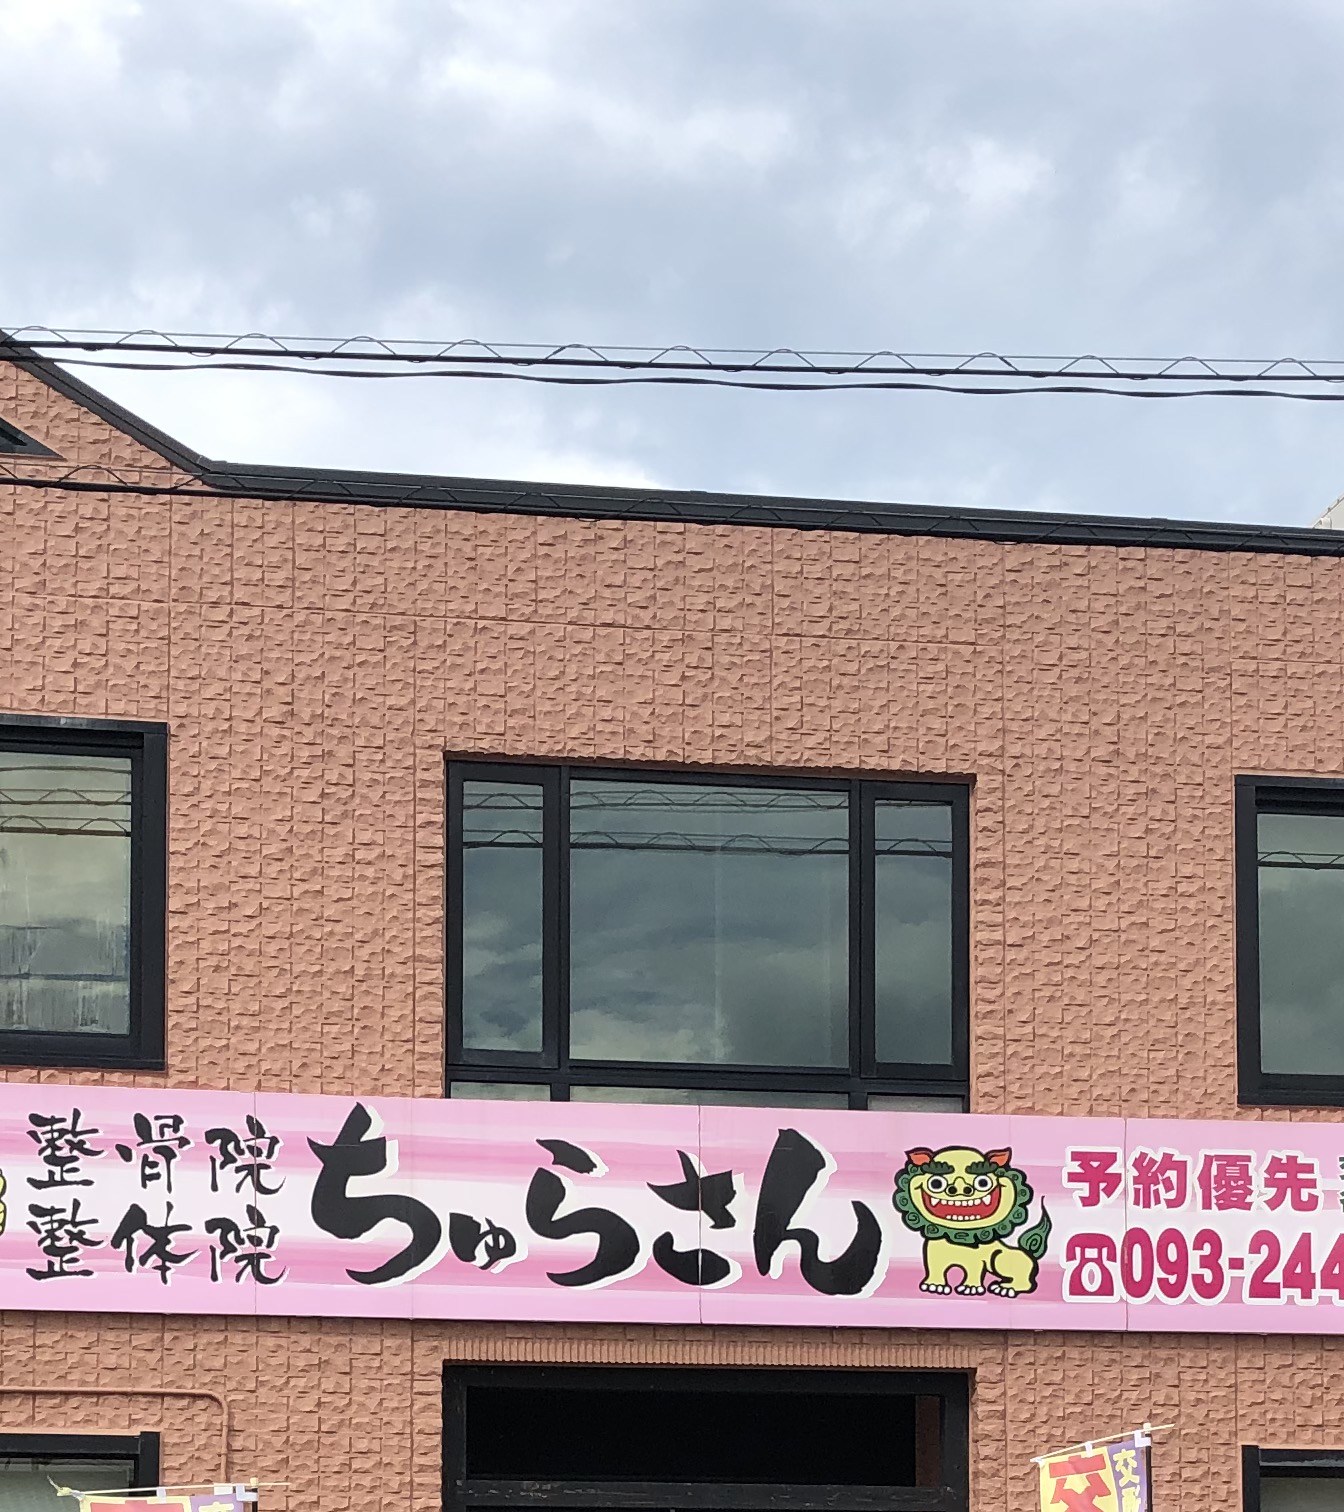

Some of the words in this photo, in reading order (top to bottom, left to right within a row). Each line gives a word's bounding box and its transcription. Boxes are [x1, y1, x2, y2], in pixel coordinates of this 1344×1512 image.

[26, 1108, 286, 1195] 整骨院
[1067, 1151, 1319, 1211] 予約優先
[26, 1198, 286, 1285] 整体院
[307, 1101, 882, 1297] ちゅらさん
